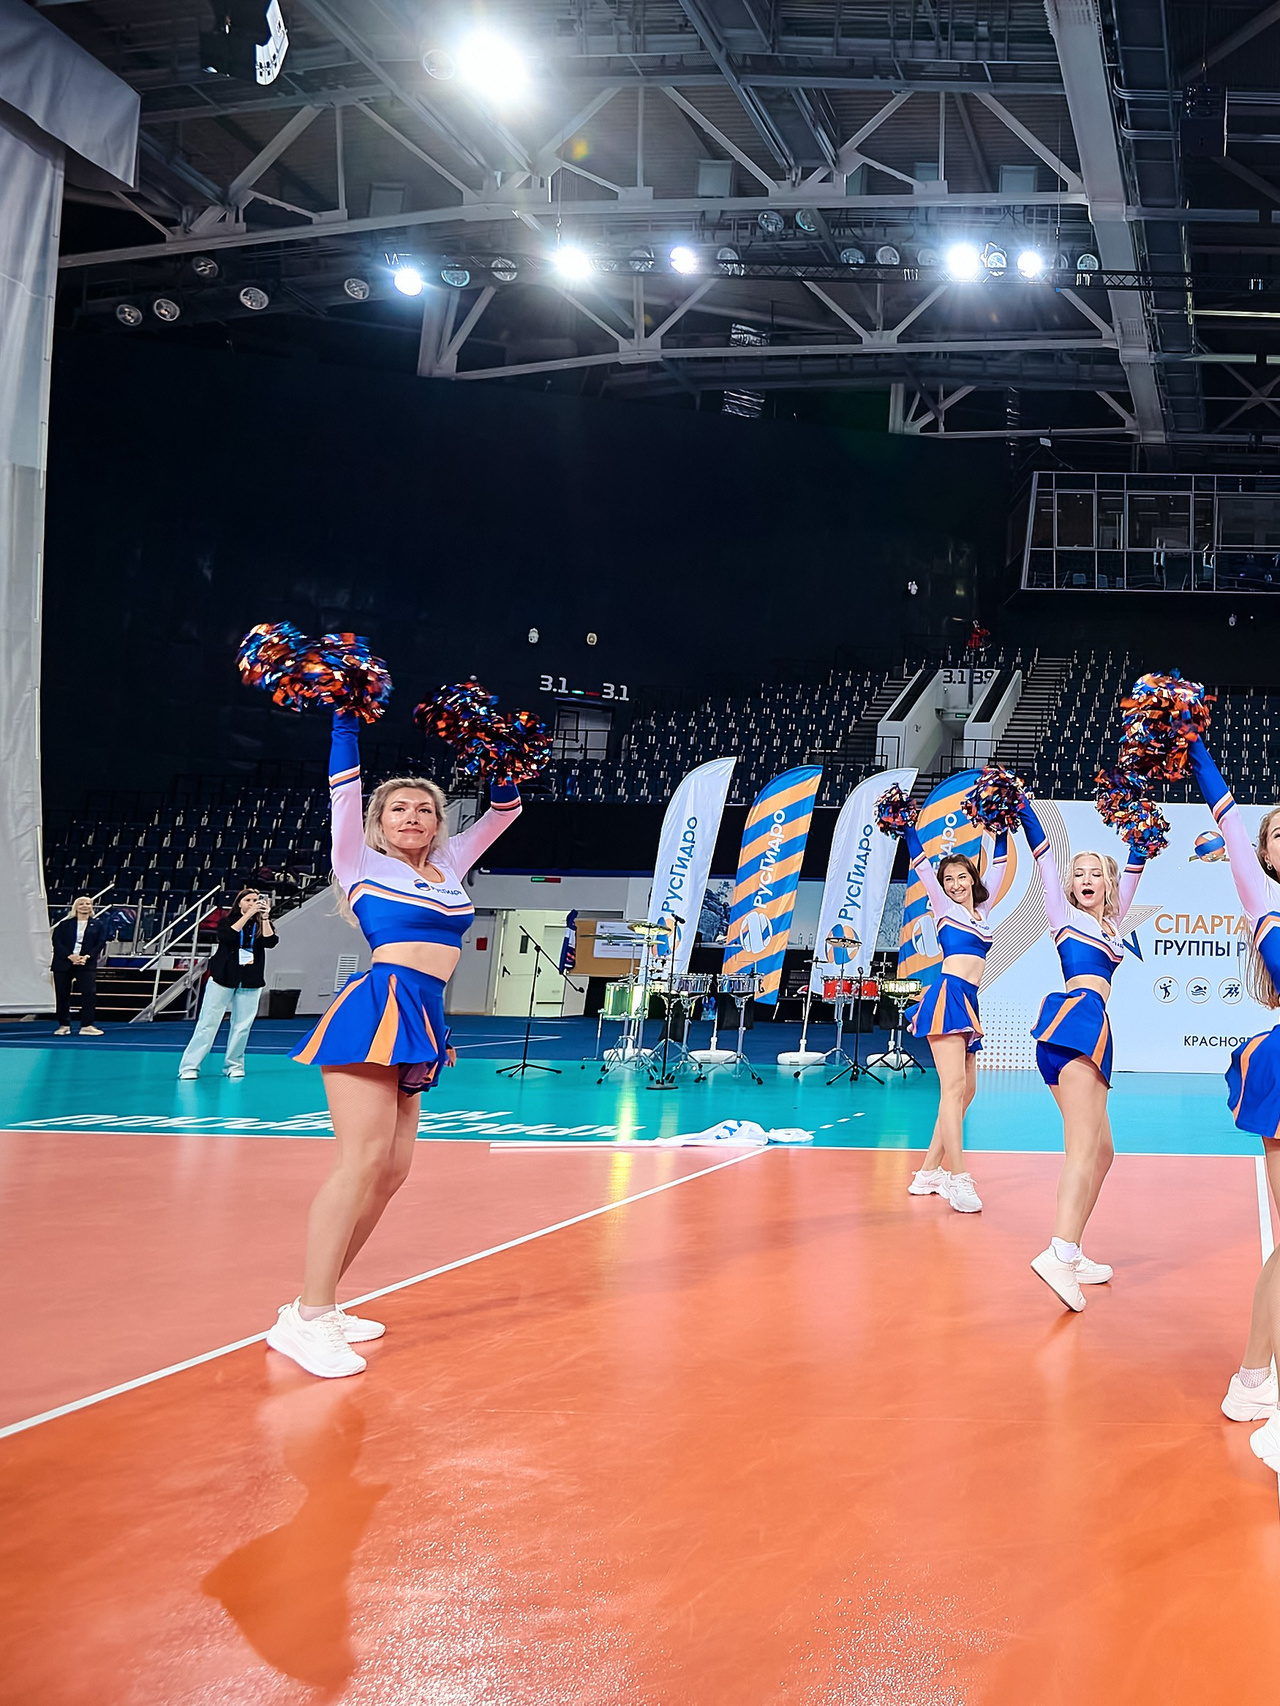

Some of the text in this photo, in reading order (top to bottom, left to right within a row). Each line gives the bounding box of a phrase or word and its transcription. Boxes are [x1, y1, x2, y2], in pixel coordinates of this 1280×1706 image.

[539, 675, 630, 701] 3.1 3.1
[942, 669, 967, 685] 3.1
[662, 816, 698, 913] РусГидро
[754, 809, 786, 909] РусГидро
[838, 823, 873, 921] РусГидро
[1154, 939, 1231, 957] ГРУППЫ
